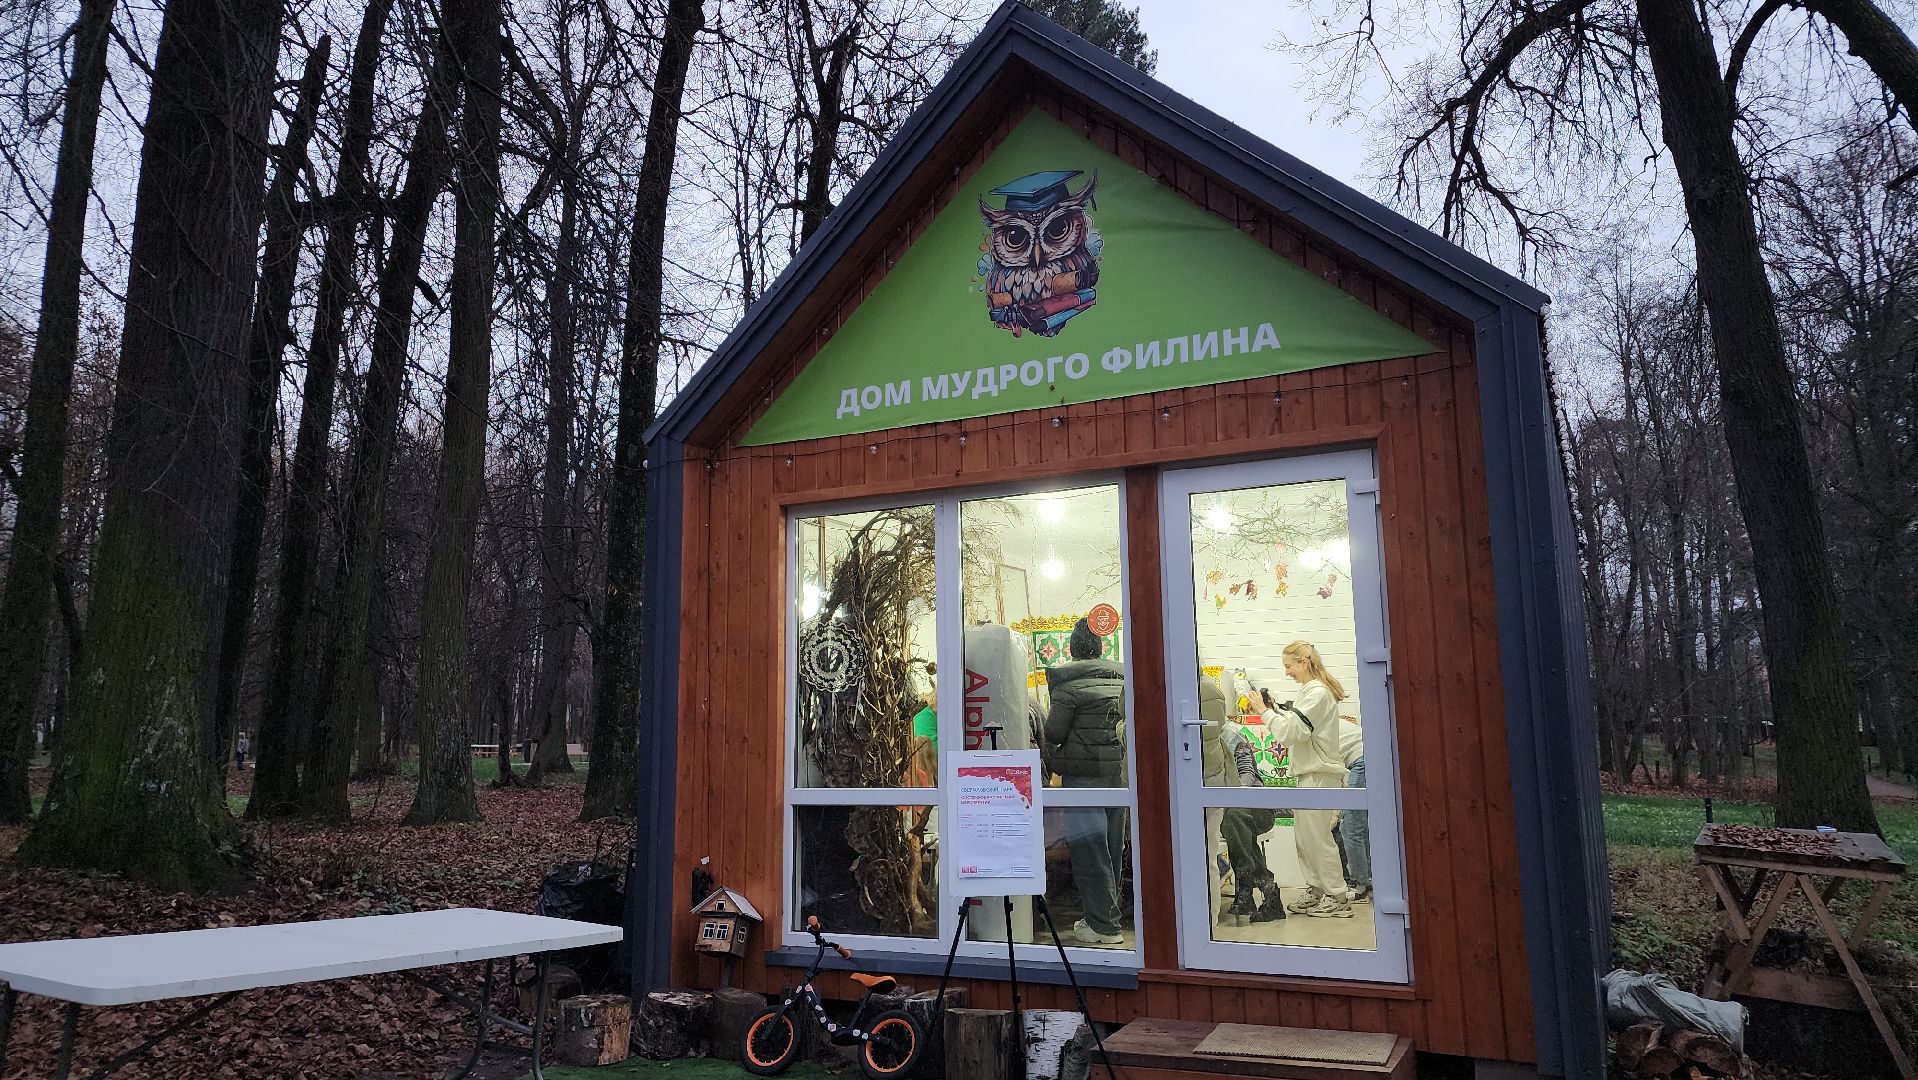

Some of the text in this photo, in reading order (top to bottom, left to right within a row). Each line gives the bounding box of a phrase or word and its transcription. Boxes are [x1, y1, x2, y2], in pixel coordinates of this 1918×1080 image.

[836, 322, 1281, 420] ДОМ МУДРОГО ФИЛИНА
[964, 668, 990, 750] Alph
